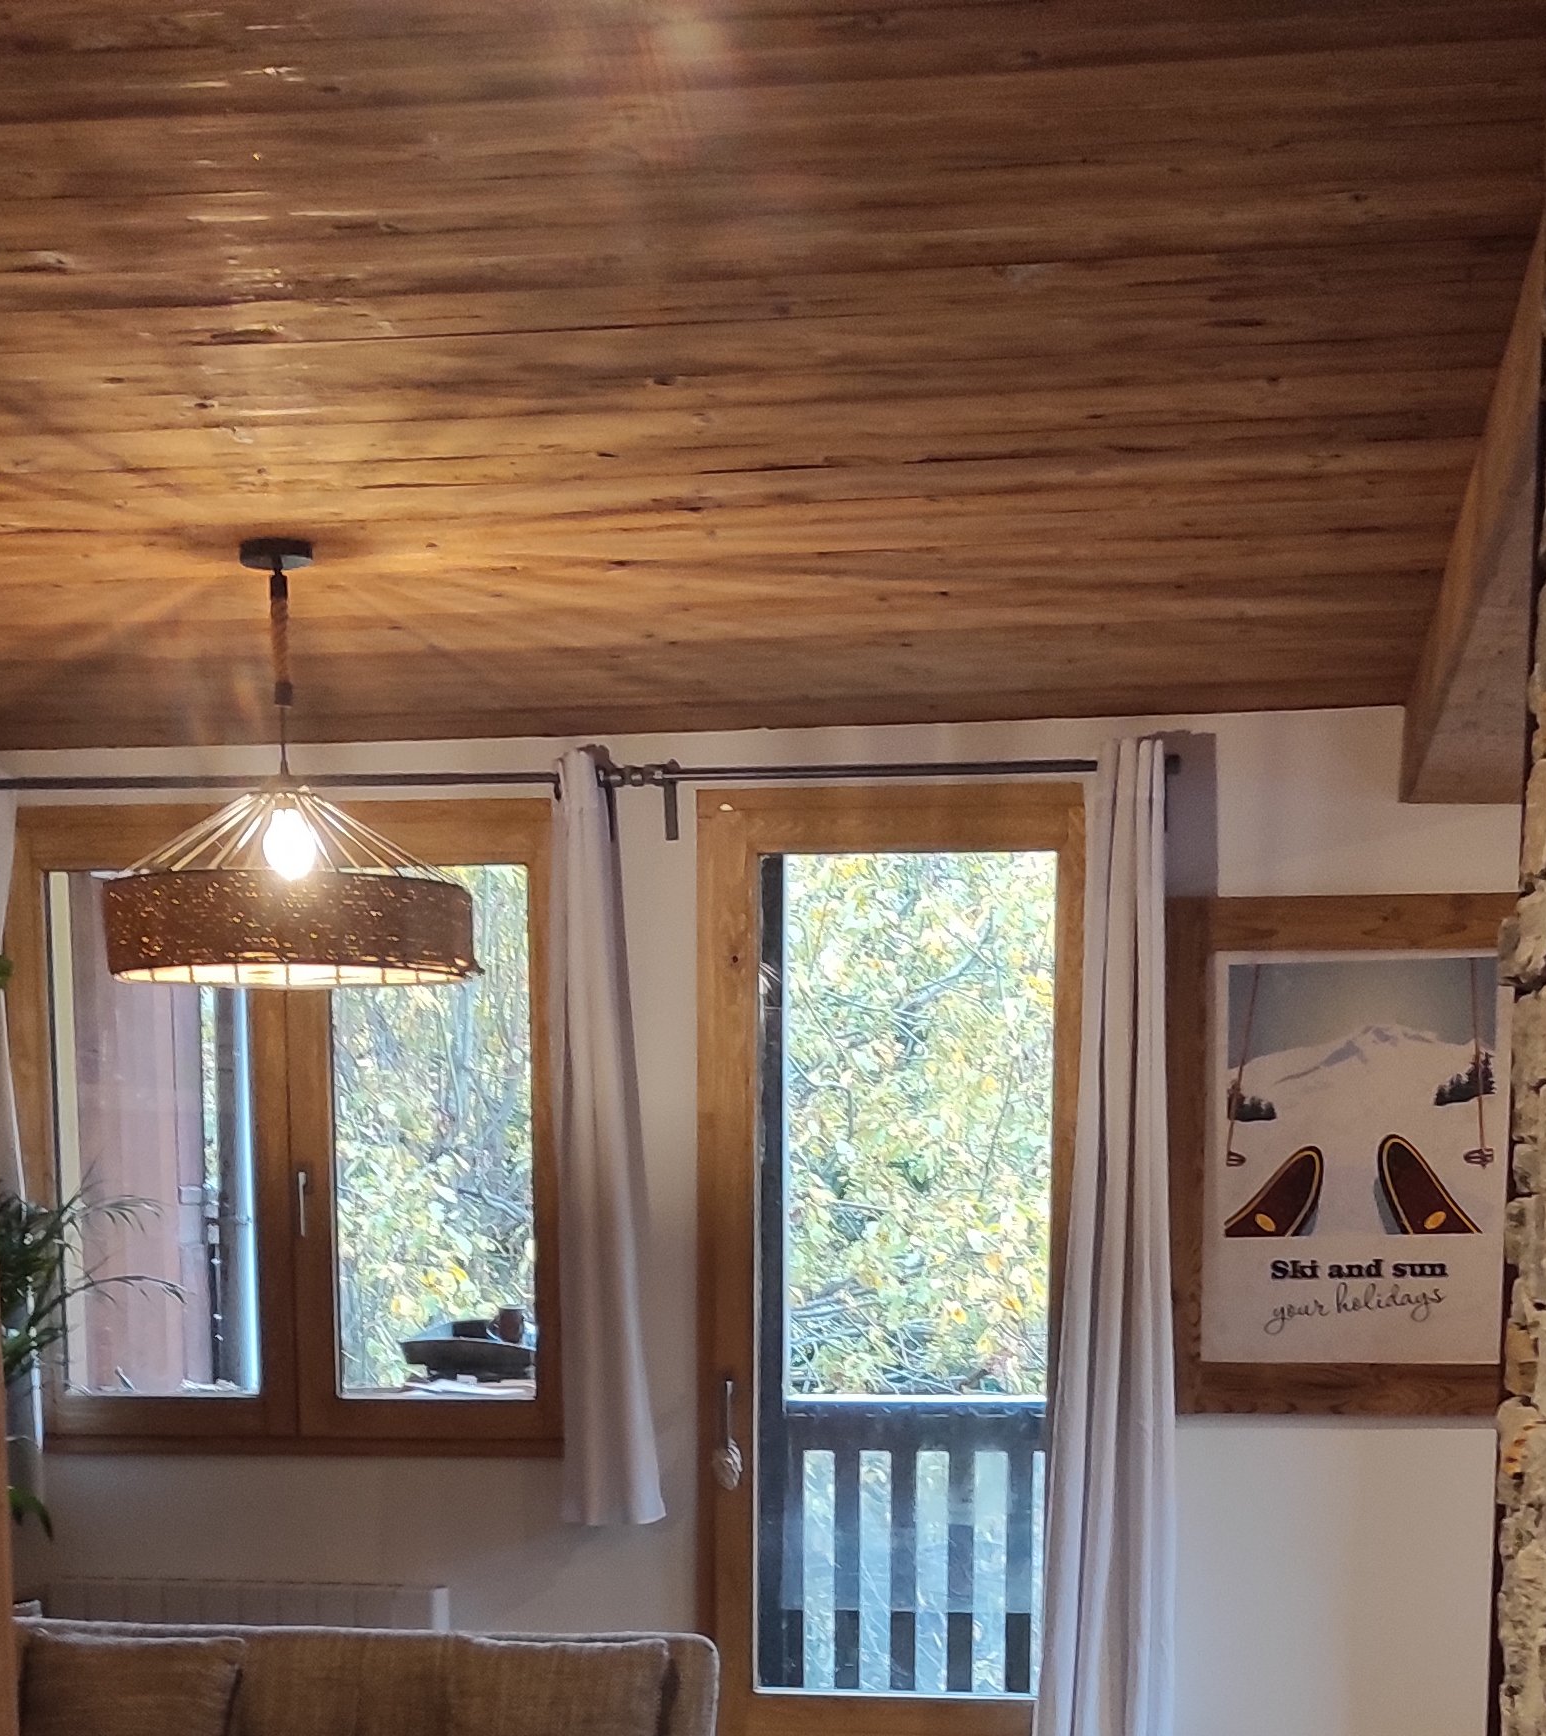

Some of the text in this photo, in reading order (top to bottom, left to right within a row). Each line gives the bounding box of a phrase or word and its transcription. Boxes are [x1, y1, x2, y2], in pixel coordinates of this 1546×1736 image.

[1270, 1258, 1449, 1280] Ski and sun
[1263, 1281, 1447, 1335] your holidays
